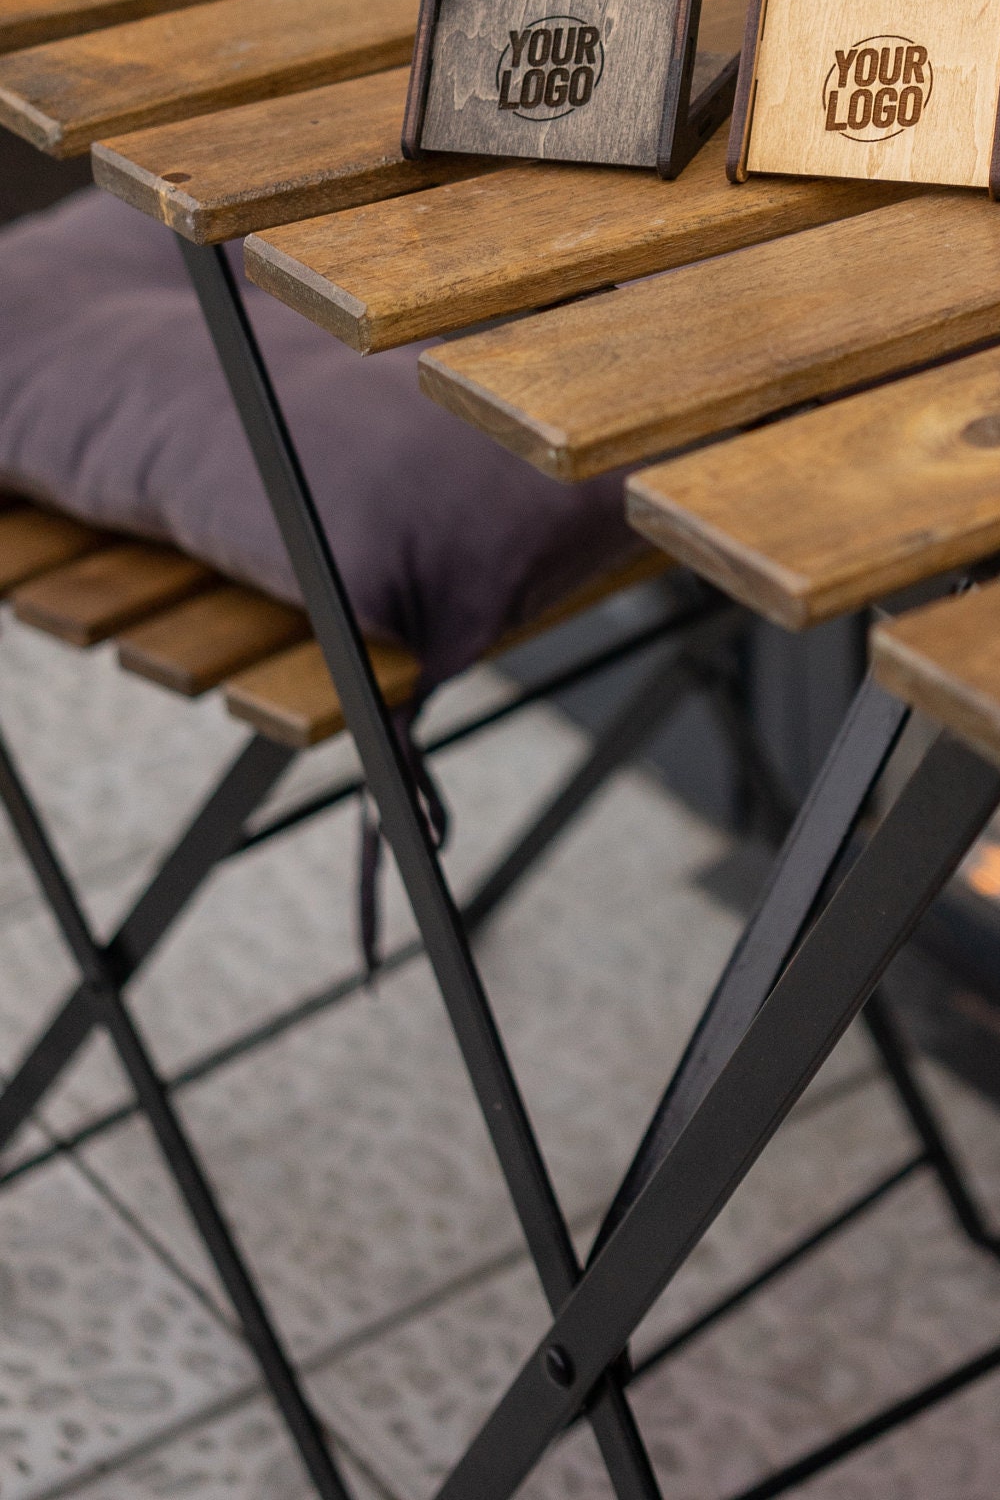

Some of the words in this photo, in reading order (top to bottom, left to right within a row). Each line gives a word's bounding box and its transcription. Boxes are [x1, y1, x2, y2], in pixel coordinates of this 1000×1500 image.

[508, 25, 601, 68] YOUR
[834, 45, 928, 88] YOUR
[498, 64, 595, 110] LOGO
[824, 85, 923, 132] LOGO
